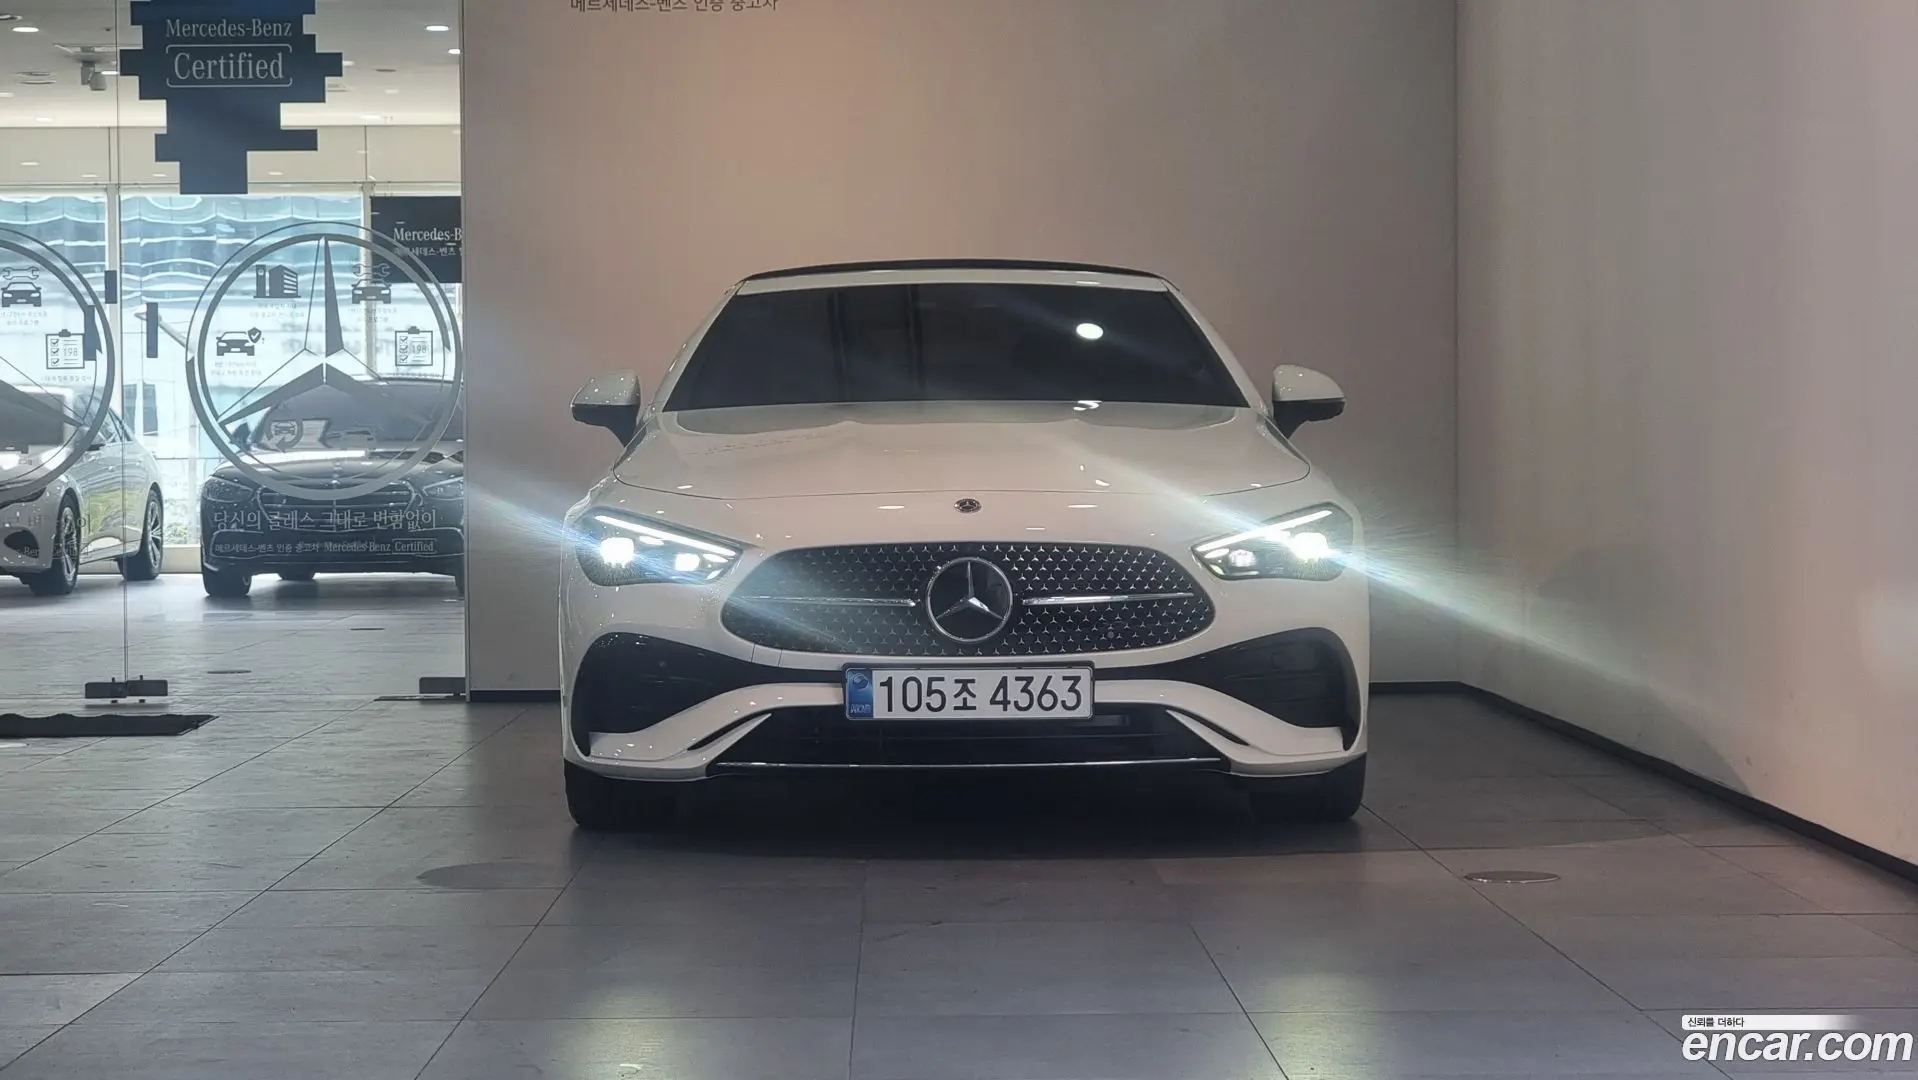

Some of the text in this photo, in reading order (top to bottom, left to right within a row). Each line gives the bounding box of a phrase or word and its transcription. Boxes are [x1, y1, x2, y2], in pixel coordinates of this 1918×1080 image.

[166, 19, 292, 37] Mercedes-Benz
[174, 52, 284, 80] Certified
[214, 510, 261, 530] 당신의
[320, 509, 368, 529] 그대로
[374, 509, 436, 530] 변함없이
[324, 541, 391, 552] Mercedes-Benz
[394, 541, 434, 552] Certified
[879, 676, 1082, 712] 105조 4363
